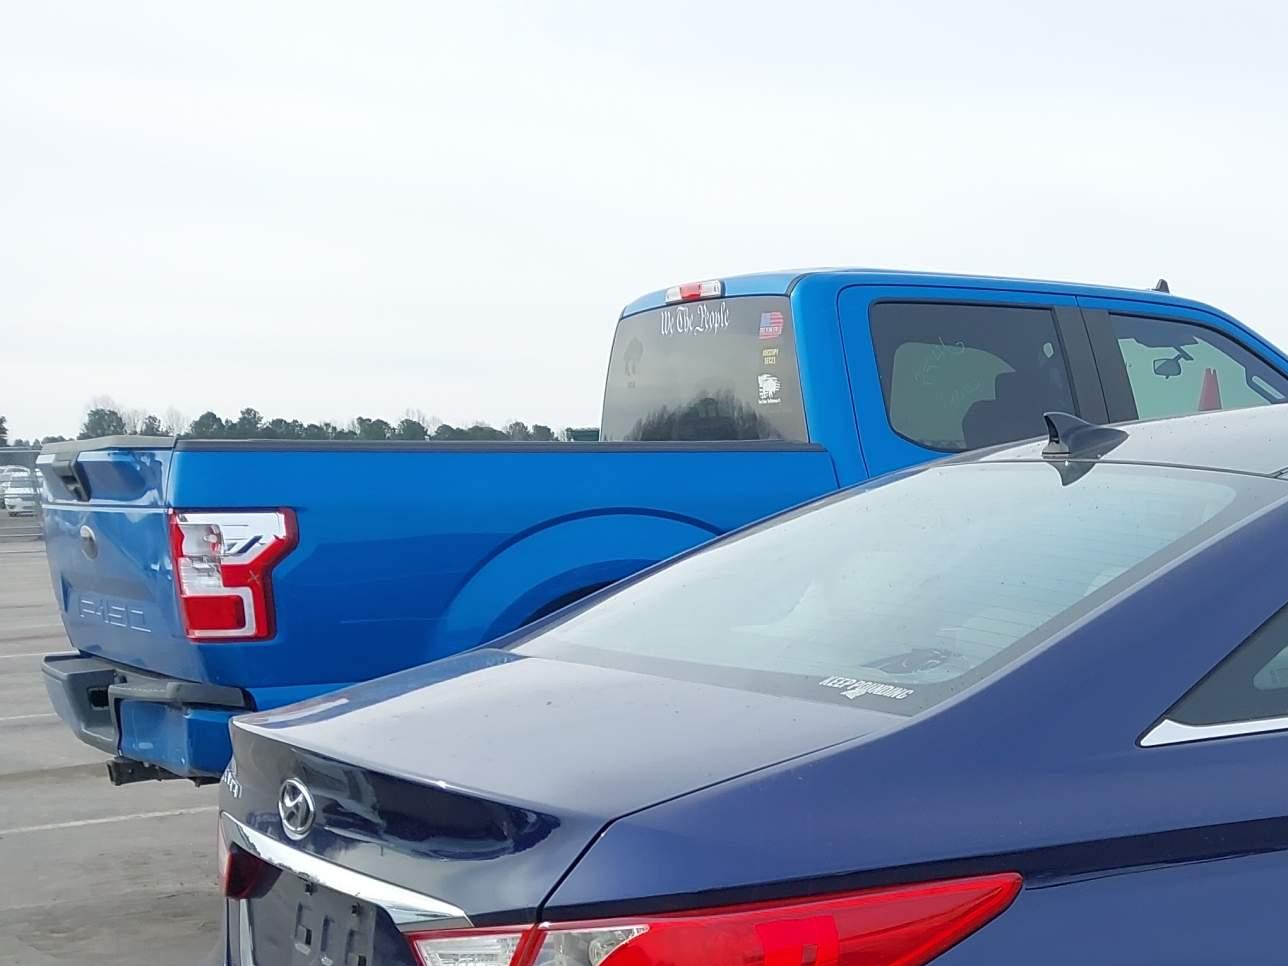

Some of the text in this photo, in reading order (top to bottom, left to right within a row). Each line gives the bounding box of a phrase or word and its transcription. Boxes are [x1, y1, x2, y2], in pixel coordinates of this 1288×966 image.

[661, 300, 729, 336] We The People
[818, 675, 915, 699] KEEP POUNDING
